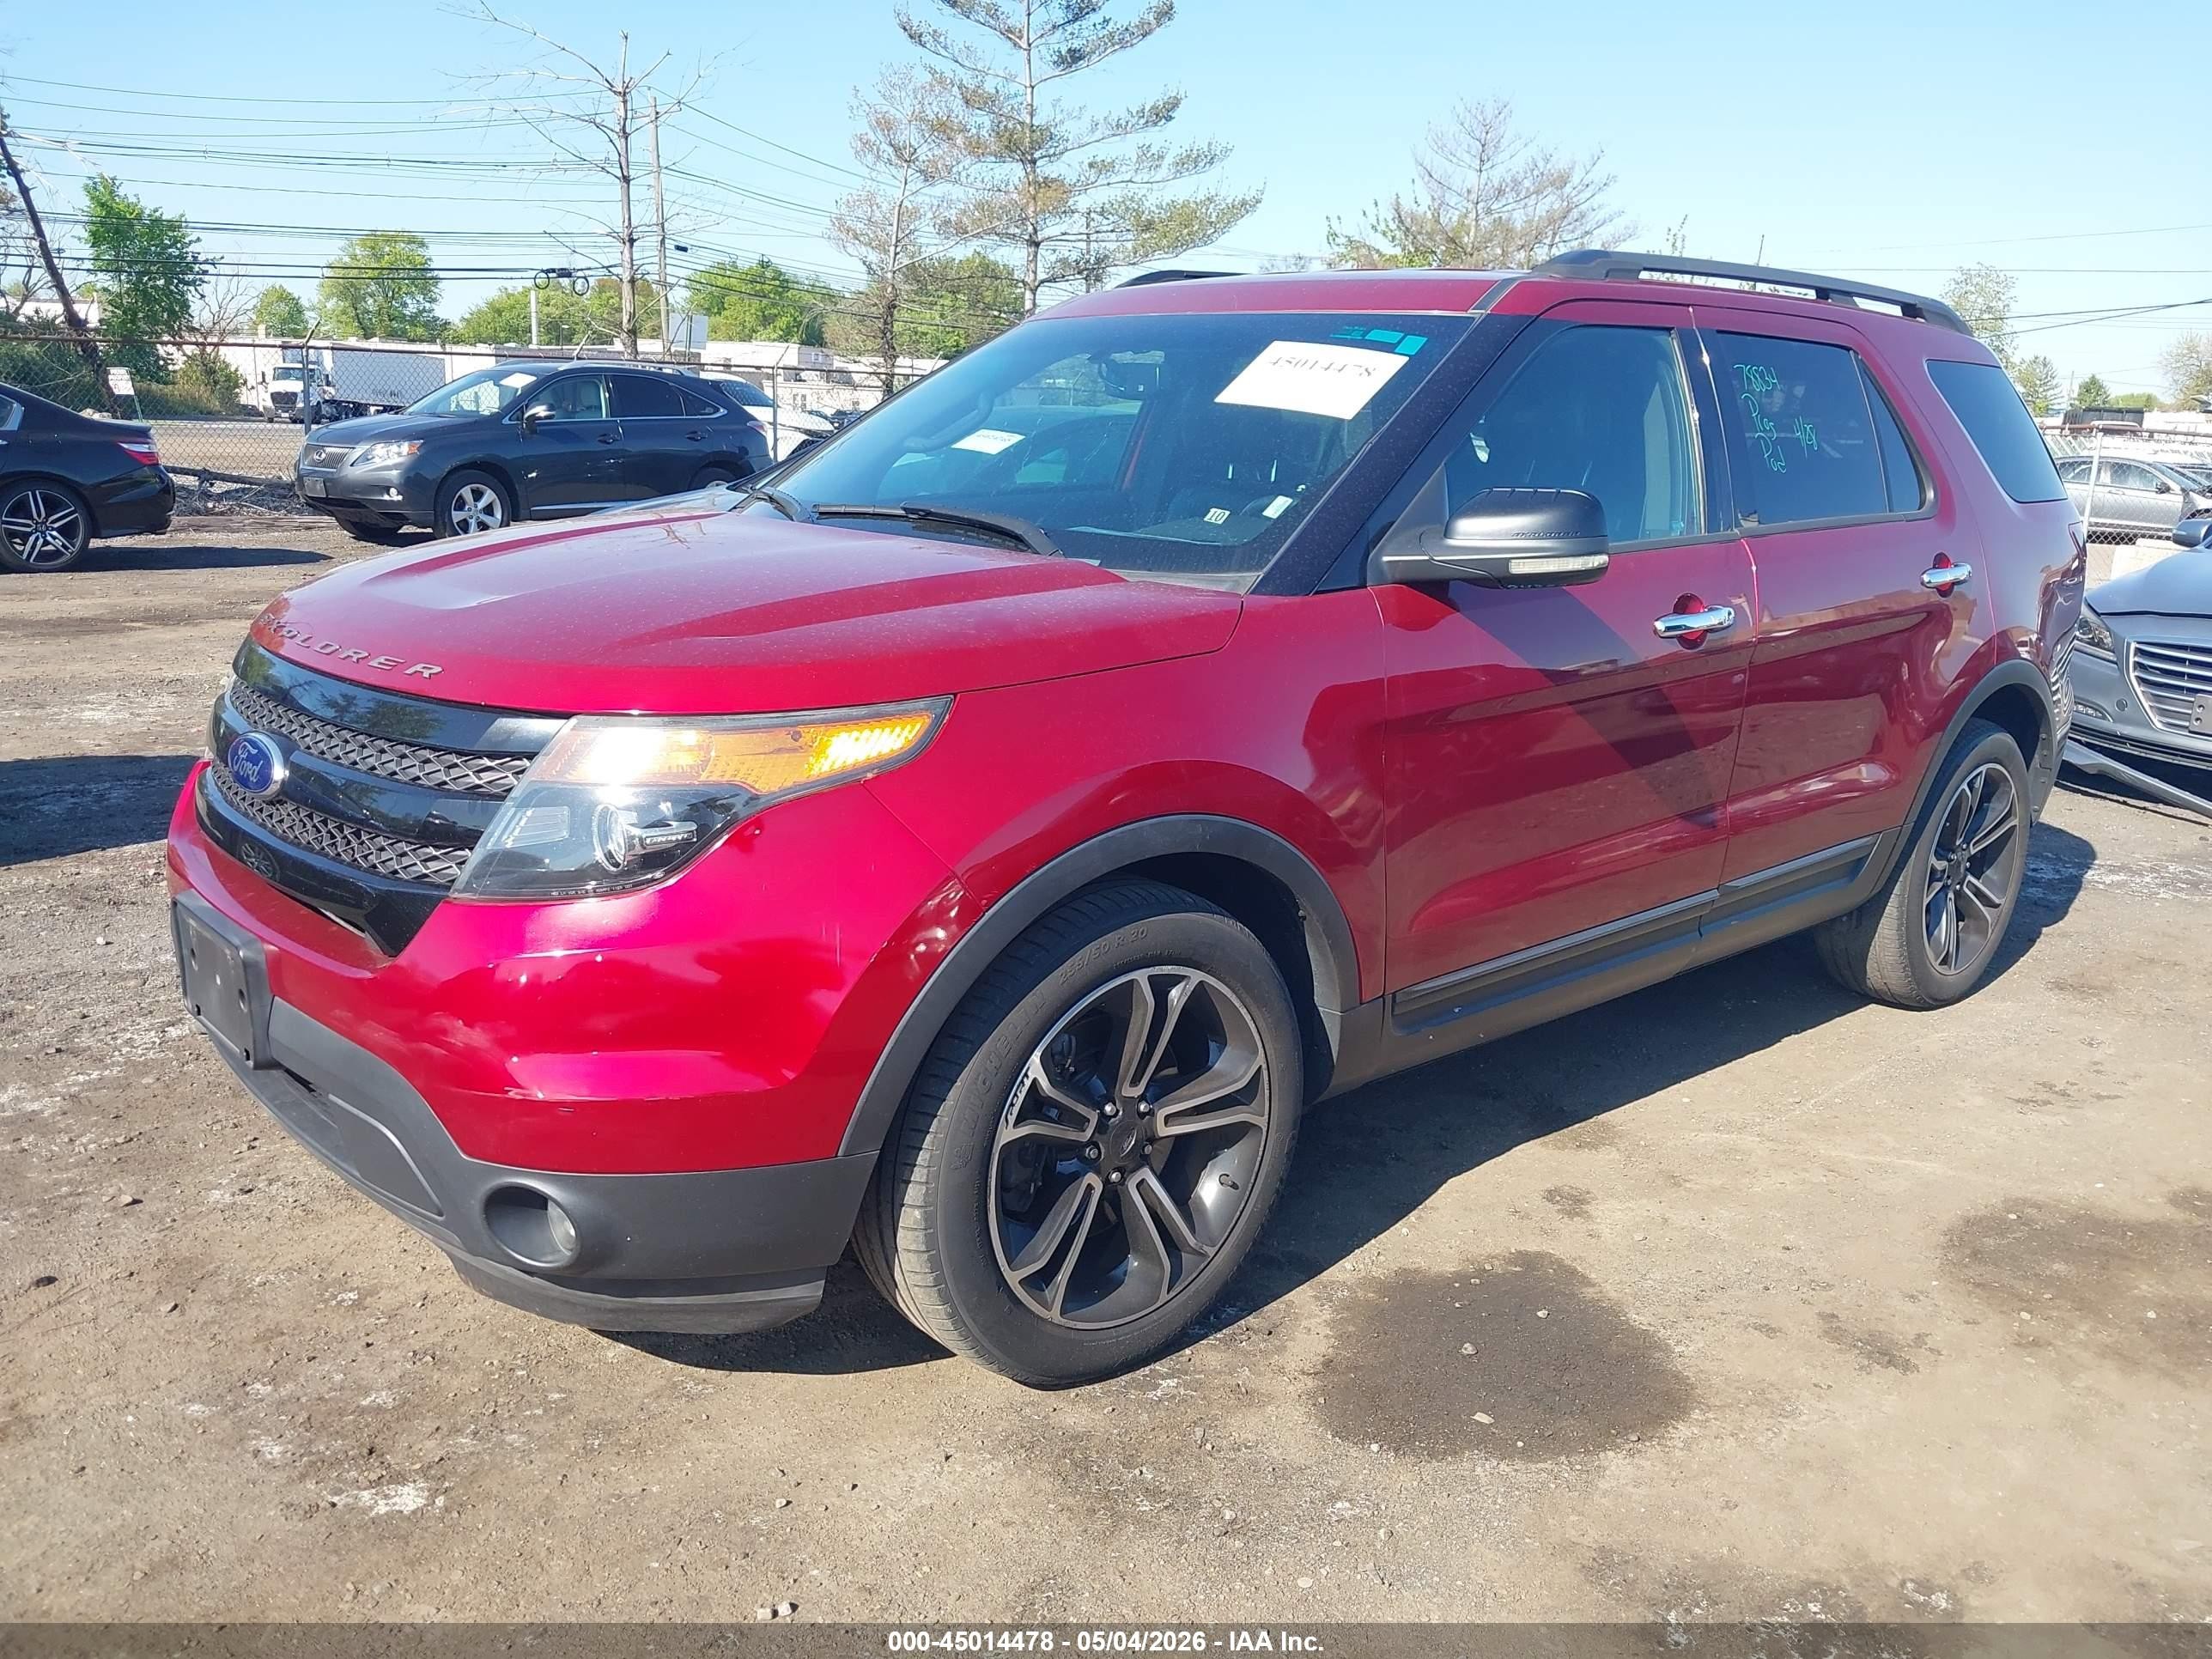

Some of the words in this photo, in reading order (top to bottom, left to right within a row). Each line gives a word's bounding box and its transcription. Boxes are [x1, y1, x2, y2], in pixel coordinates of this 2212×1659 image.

[1206, 510, 1227, 523] 10
[233, 739, 264, 783] Ford
[1058, 940, 1112, 987] 255/50
[1114, 934, 1127, 949] R
